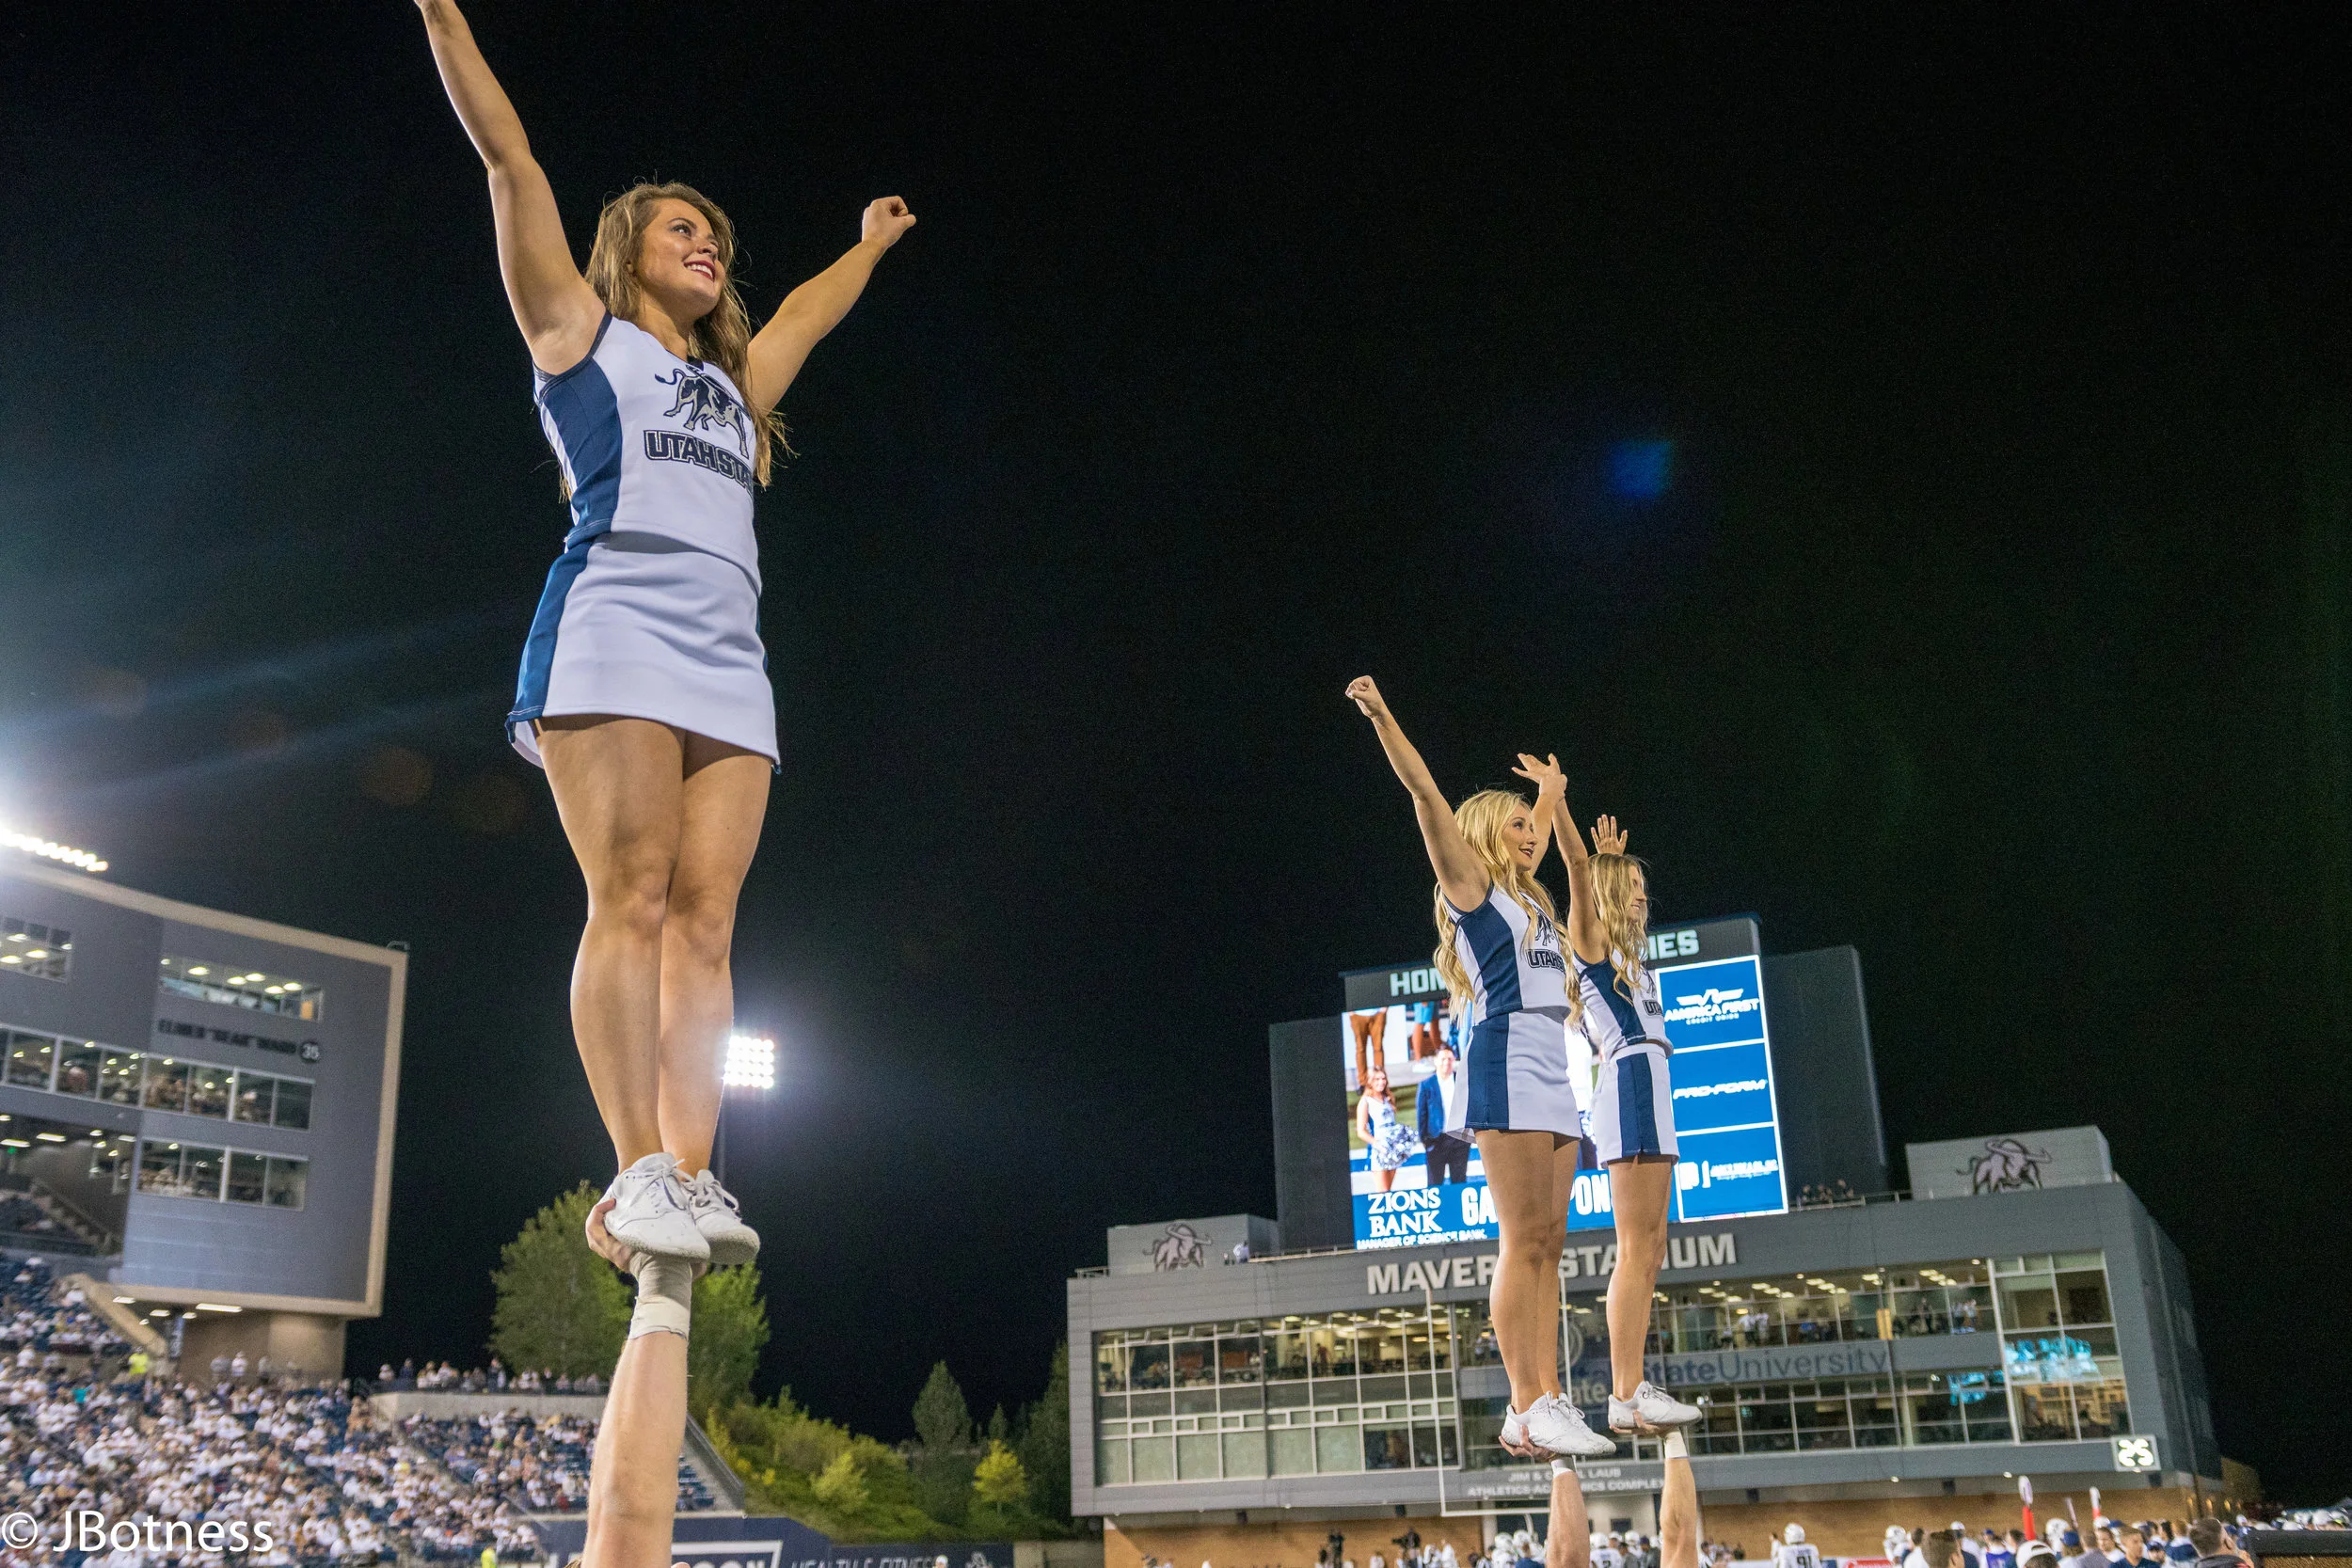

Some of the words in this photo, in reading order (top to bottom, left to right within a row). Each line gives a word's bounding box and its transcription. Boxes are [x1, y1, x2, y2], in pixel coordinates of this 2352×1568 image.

[1390, 968, 1447, 997] HOM
[1640, 929, 1700, 961] IES
[1368, 1187, 1441, 1214] ZIONS
[1369, 1210, 1443, 1238] BANK
[1366, 1254, 1498, 1295] MAVER
[1508, 1472, 1530, 1483] JIM
[1587, 1467, 1621, 1480] LAUB
